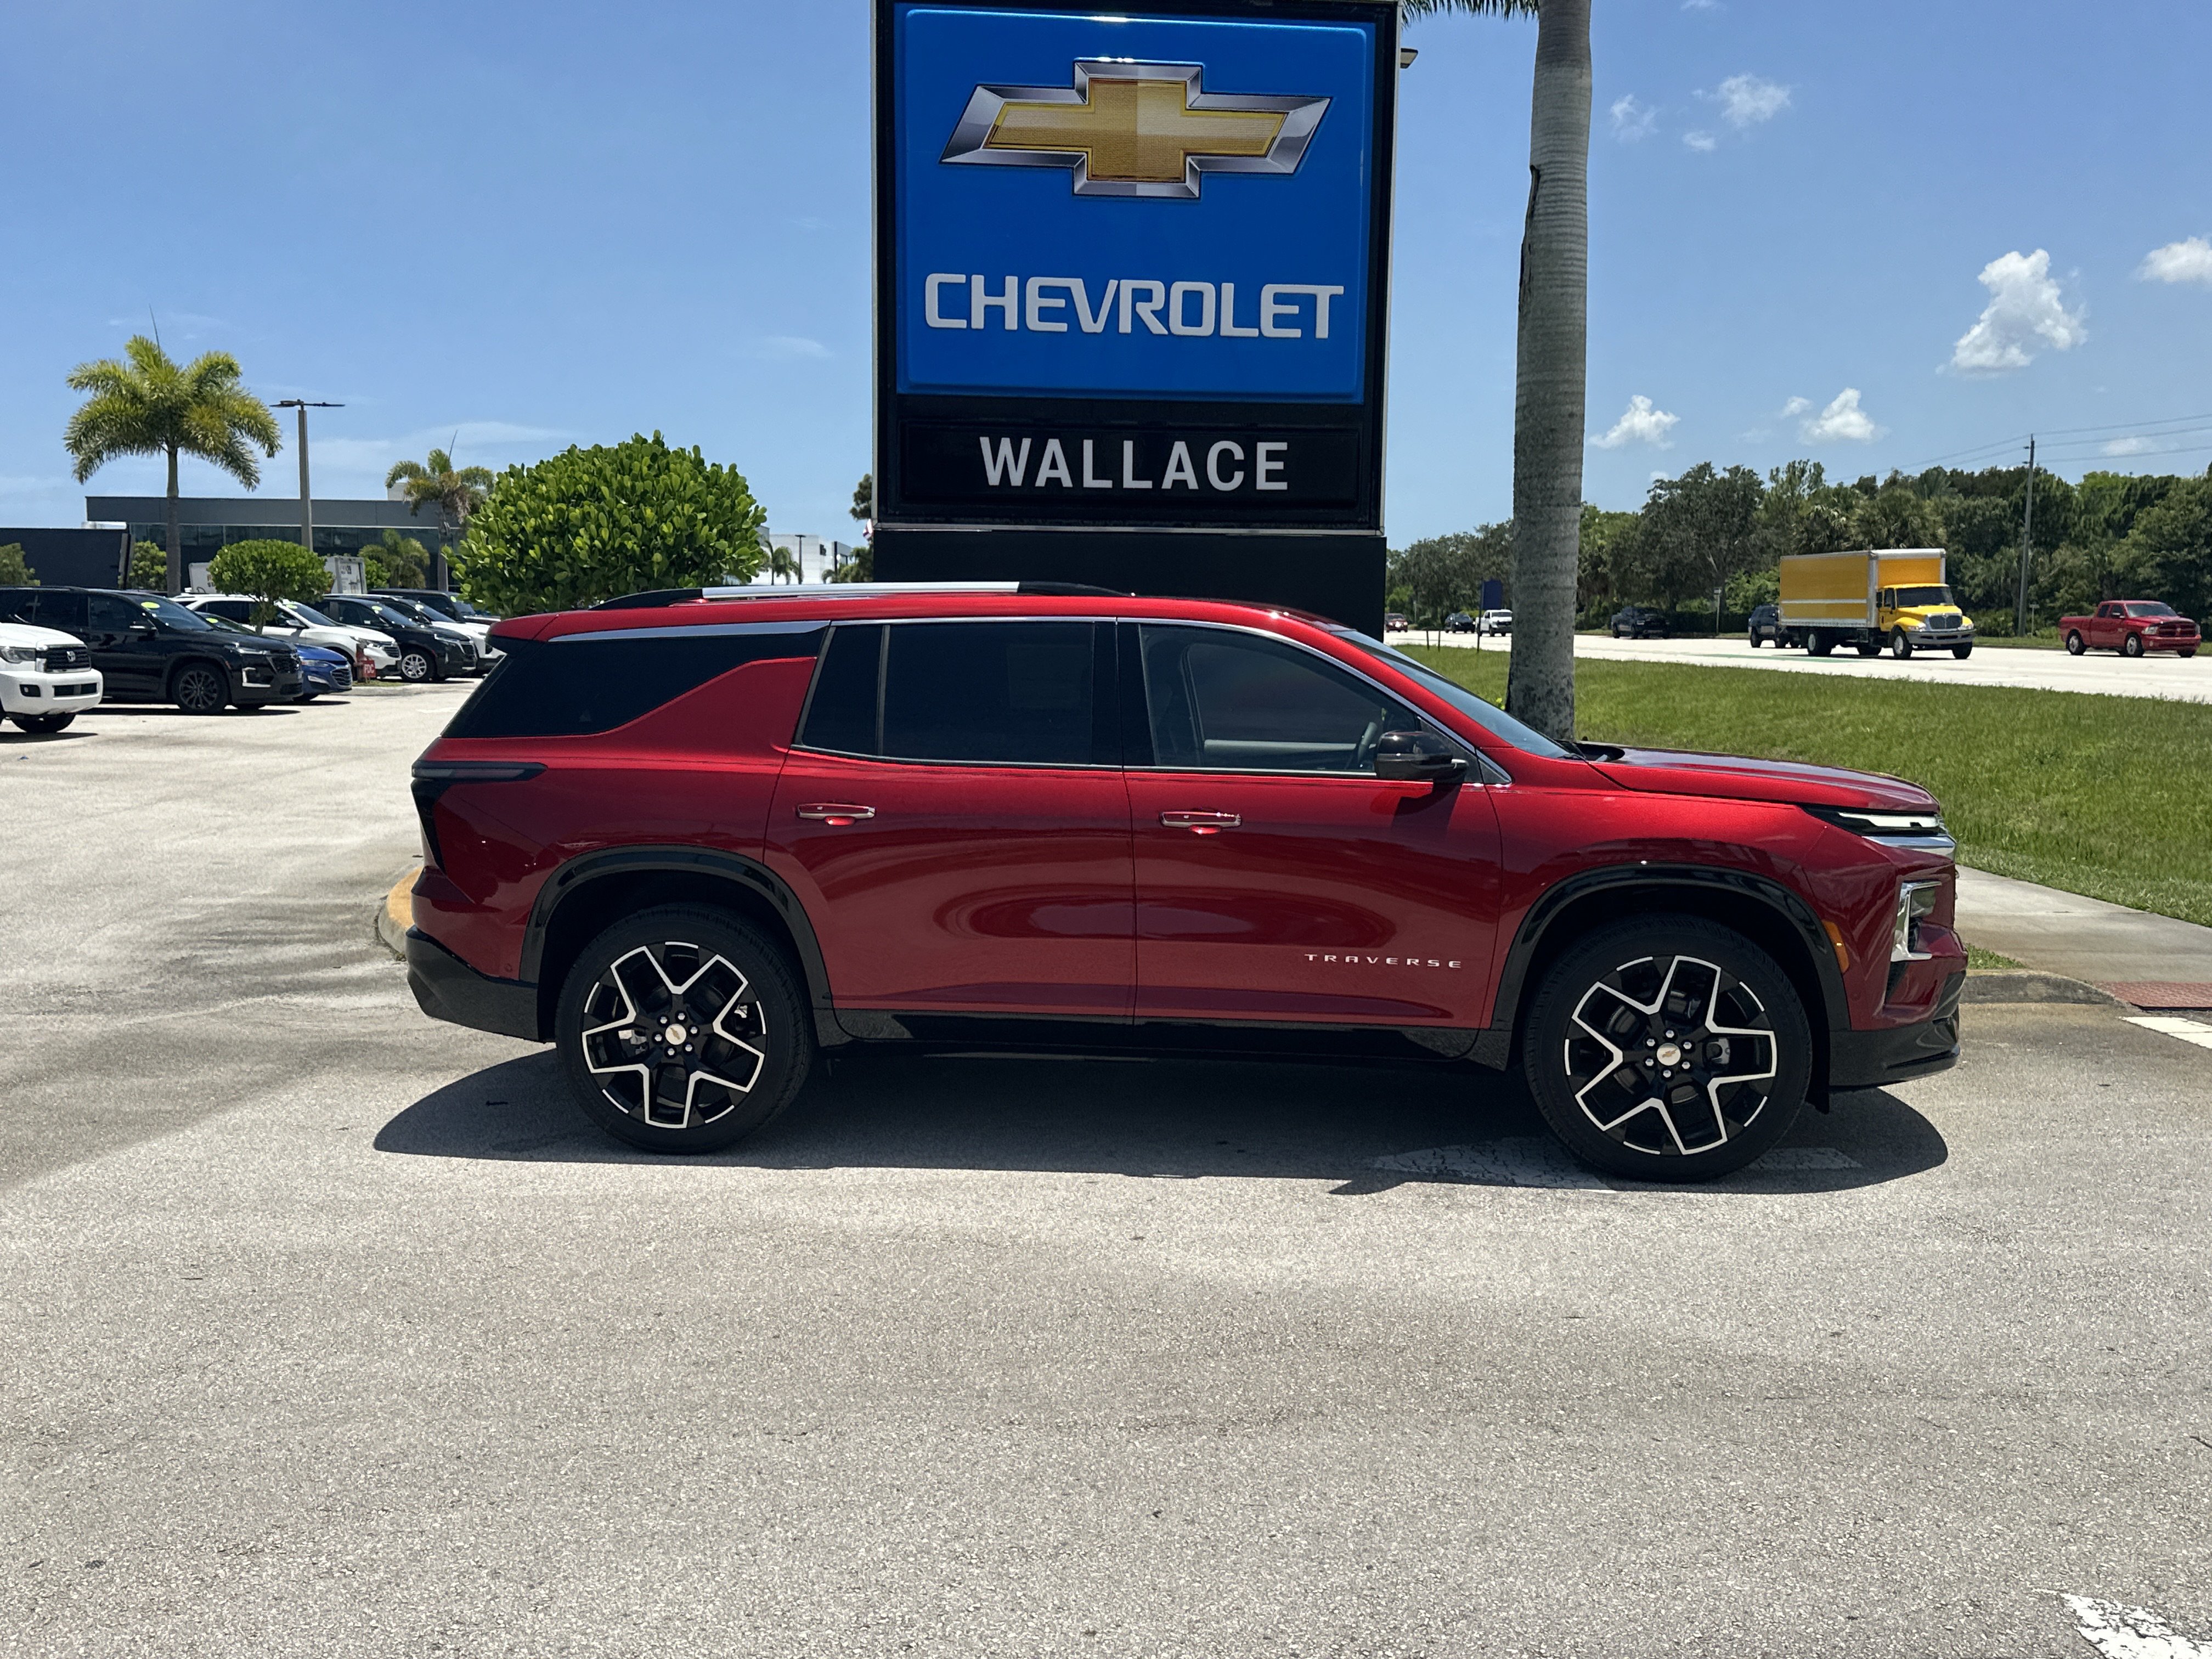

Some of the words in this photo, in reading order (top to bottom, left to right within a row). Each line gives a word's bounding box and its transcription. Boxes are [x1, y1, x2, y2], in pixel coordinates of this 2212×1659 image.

[925, 273, 1344, 338] CHEVROLET
[979, 437, 1288, 491] WALLACE
[1304, 953, 1461, 968] TRAVERSE
